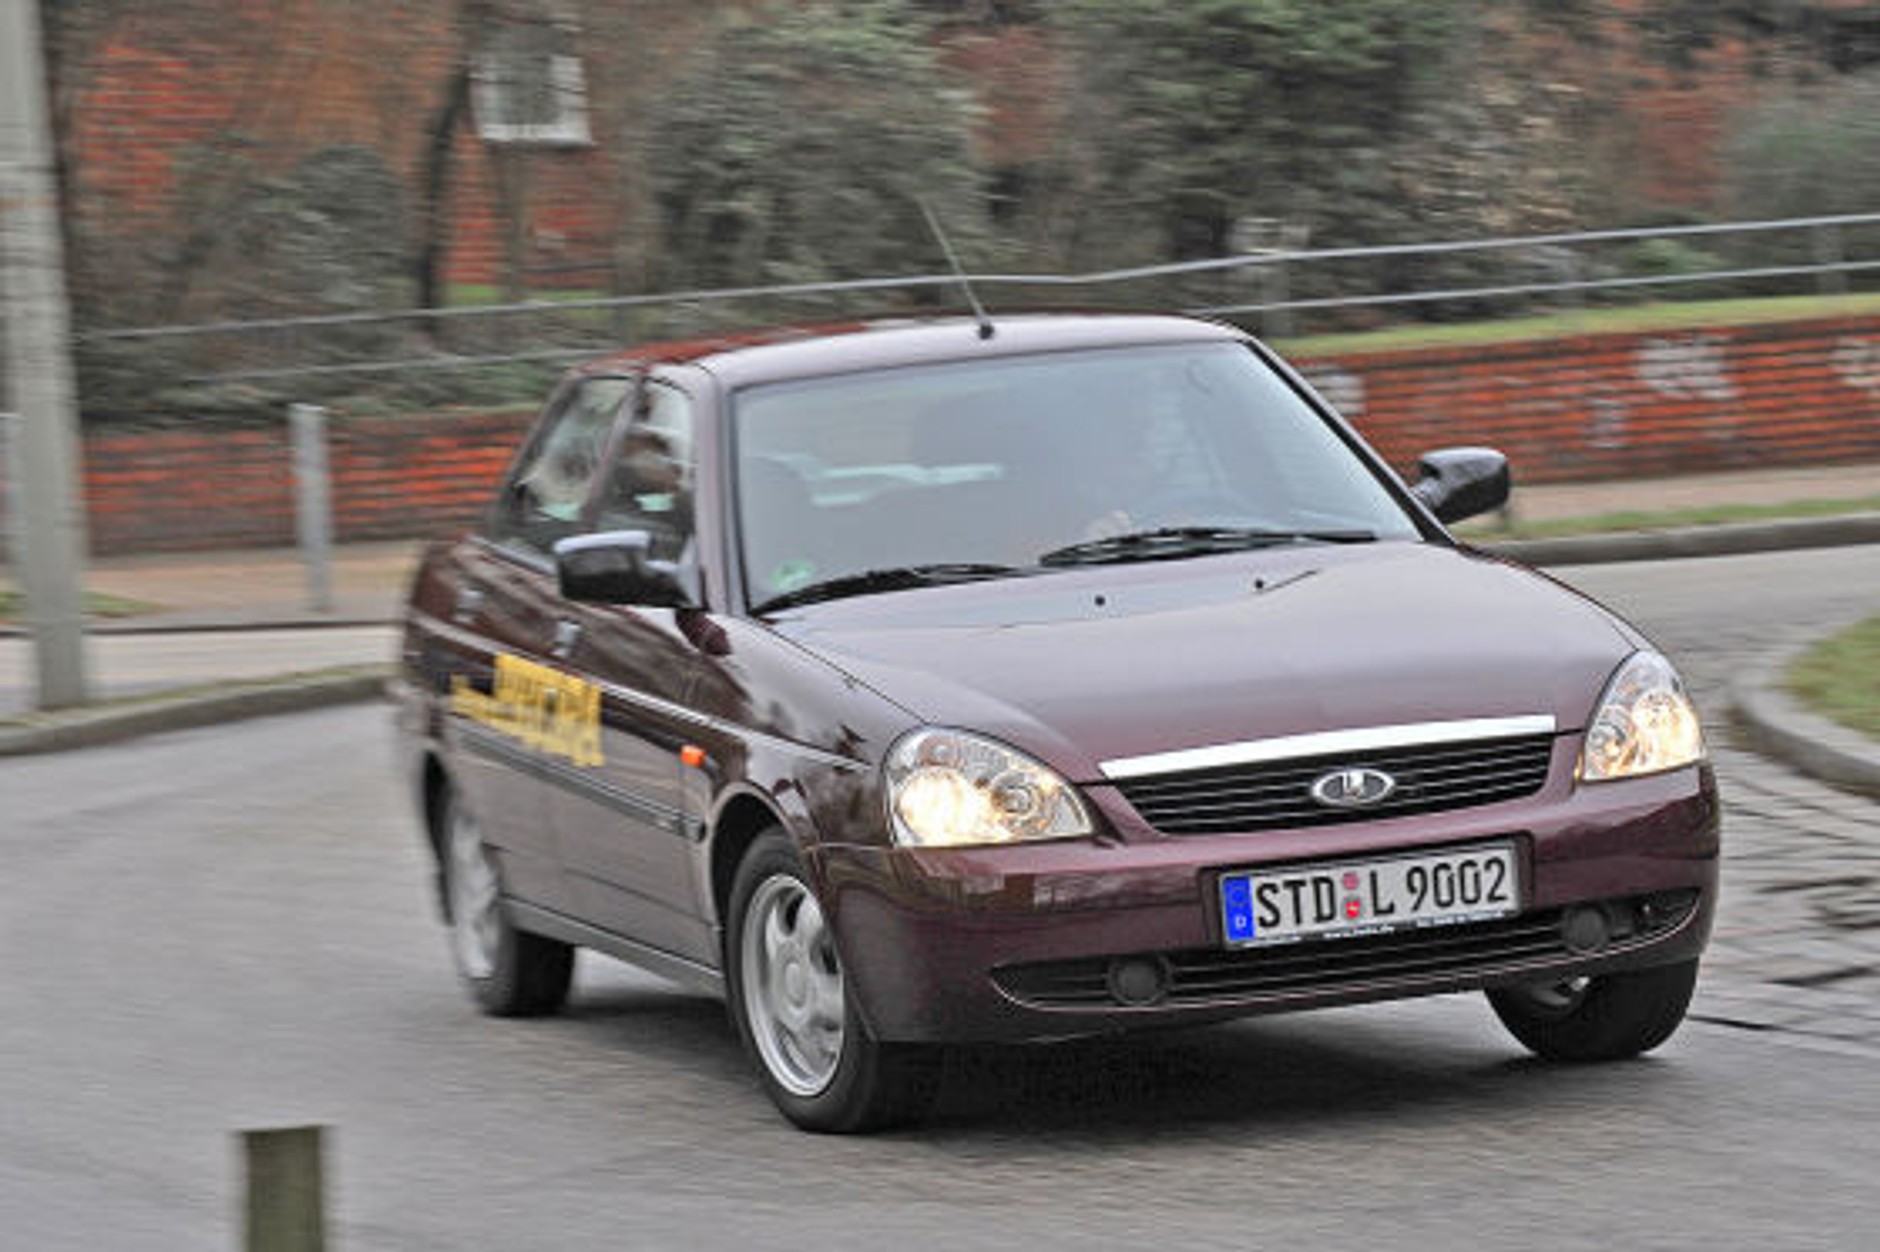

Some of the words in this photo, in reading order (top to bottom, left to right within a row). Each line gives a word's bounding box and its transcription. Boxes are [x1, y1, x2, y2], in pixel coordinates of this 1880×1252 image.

[1255, 876, 1336, 928] STD
[1369, 870, 1395, 916] L
[1406, 857, 1508, 912] 9002
